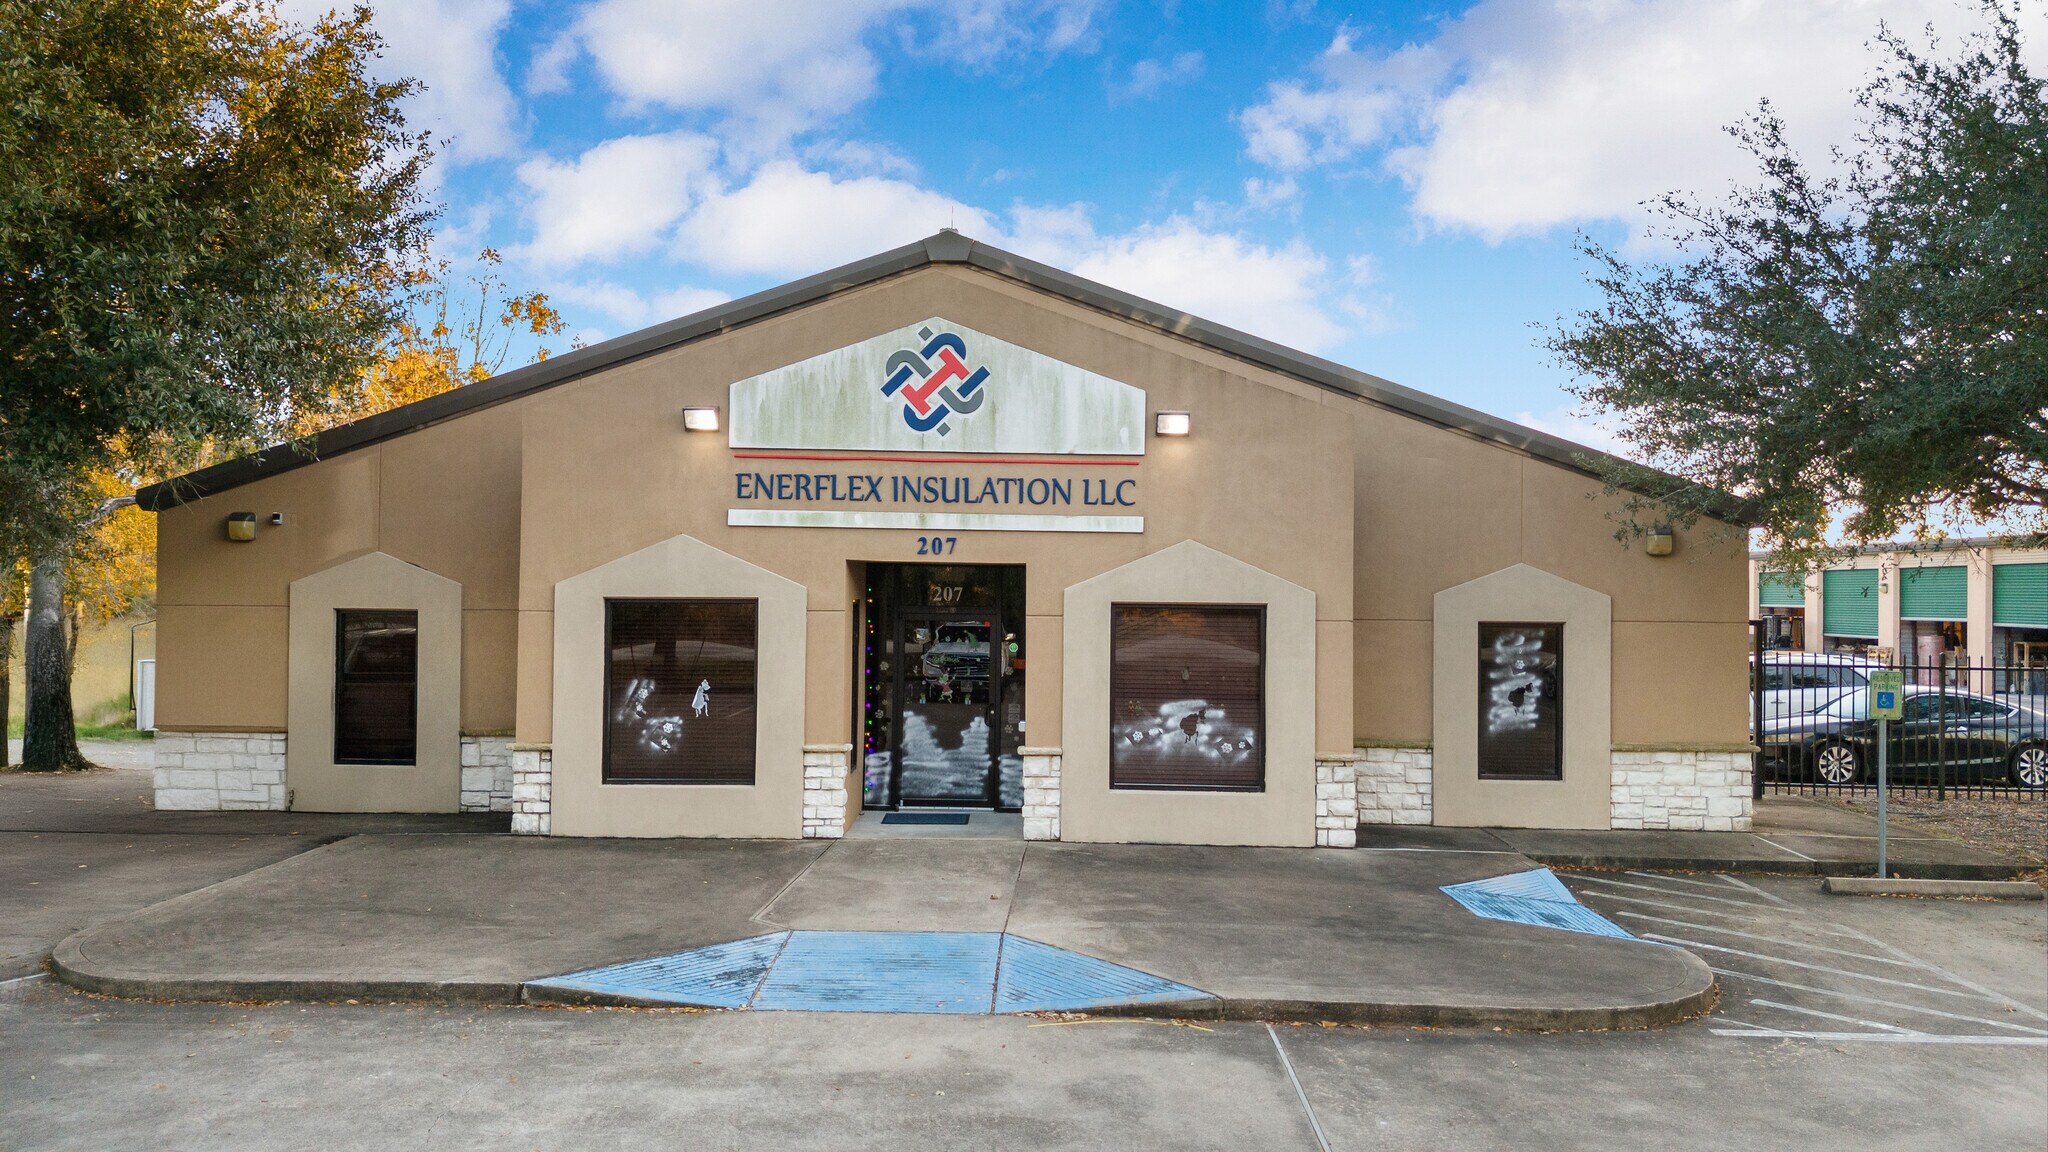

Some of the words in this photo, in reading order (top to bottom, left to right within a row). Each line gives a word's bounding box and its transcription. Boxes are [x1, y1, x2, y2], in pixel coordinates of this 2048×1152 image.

[736, 472, 883, 502] ENERFLEX
[891, 475, 1071, 505] INSULATION
[1083, 479, 1136, 506] LLC
[917, 536, 957, 555] 207
[933, 586, 963, 602] 207
